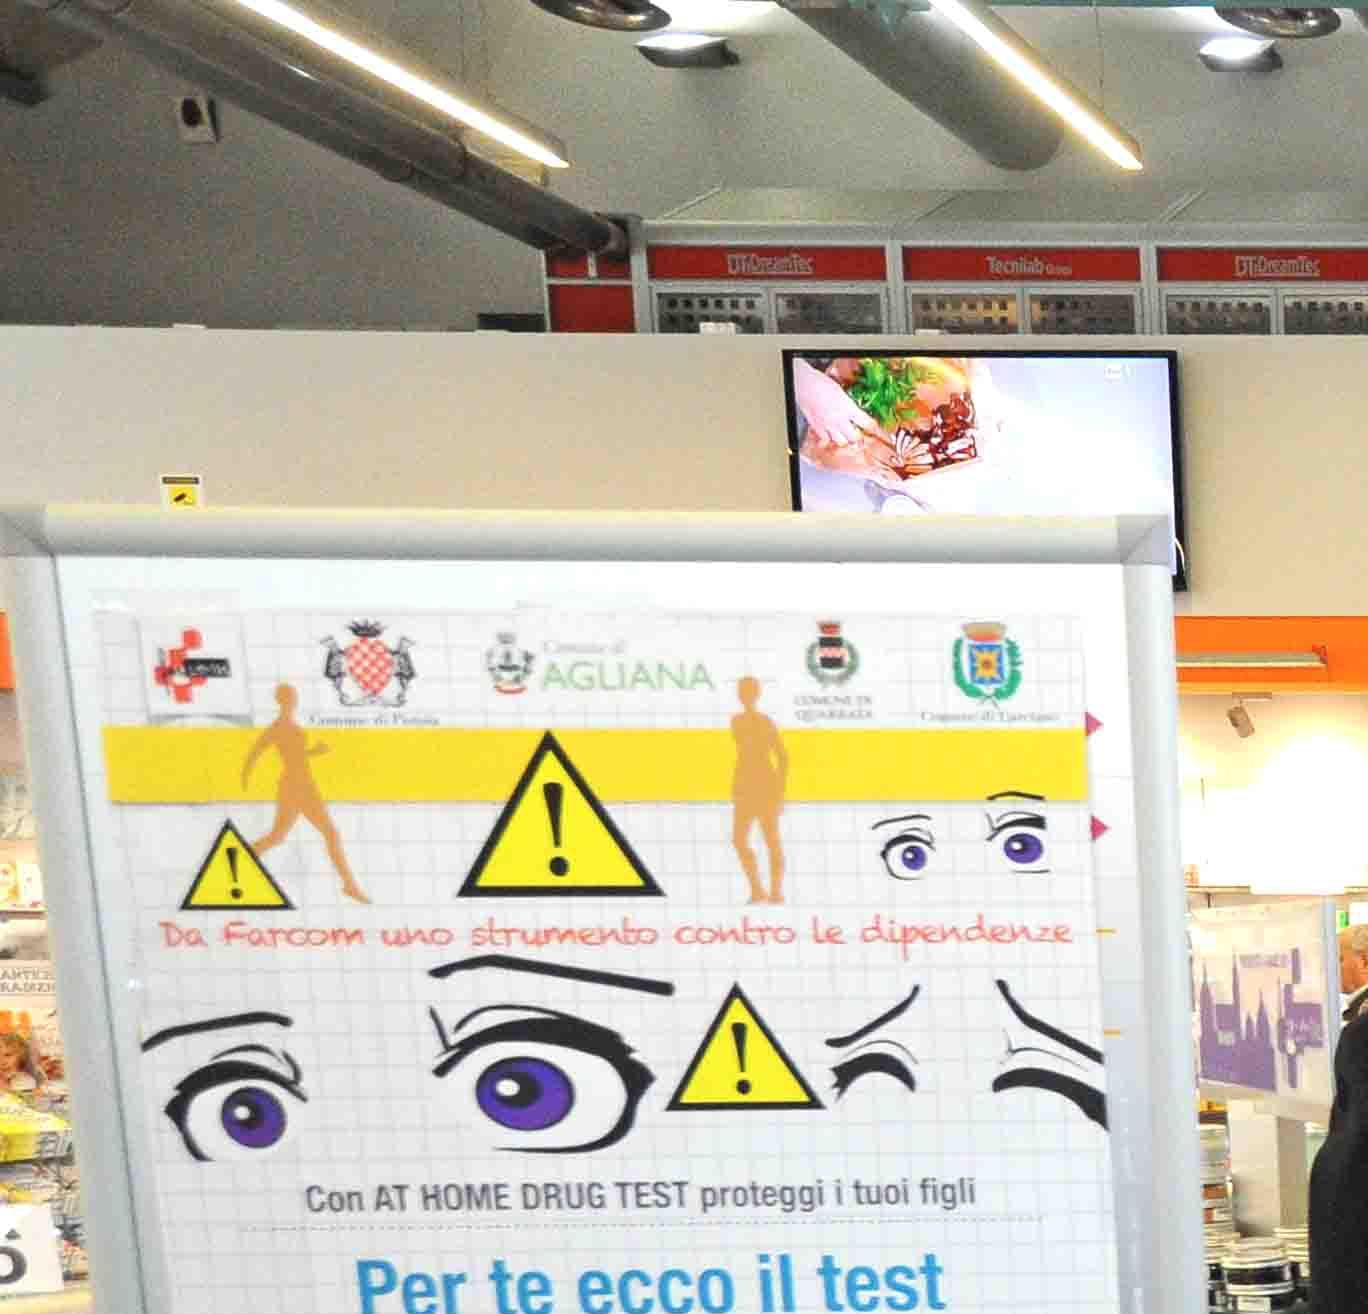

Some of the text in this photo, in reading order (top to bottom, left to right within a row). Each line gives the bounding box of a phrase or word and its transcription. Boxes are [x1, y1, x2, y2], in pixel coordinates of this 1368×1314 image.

[540, 660, 717, 693] AGLIANA
[158, 913, 1073, 960] Da Farcom uno strumento contro le dipendenze
[304, 1185, 365, 1213] Con
[374, 1184, 409, 1211] AT
[420, 1183, 512, 1211] HOME
[521, 1182, 606, 1210] DRUG
[613, 1181, 688, 1208] TEST
[701, 1179, 824, 1213] proteggi
[852, 1178, 909, 1205] tuoi
[920, 1178, 975, 1210] figli
[760, 1253, 795, 1312] il
[819, 1255, 944, 1312] test
